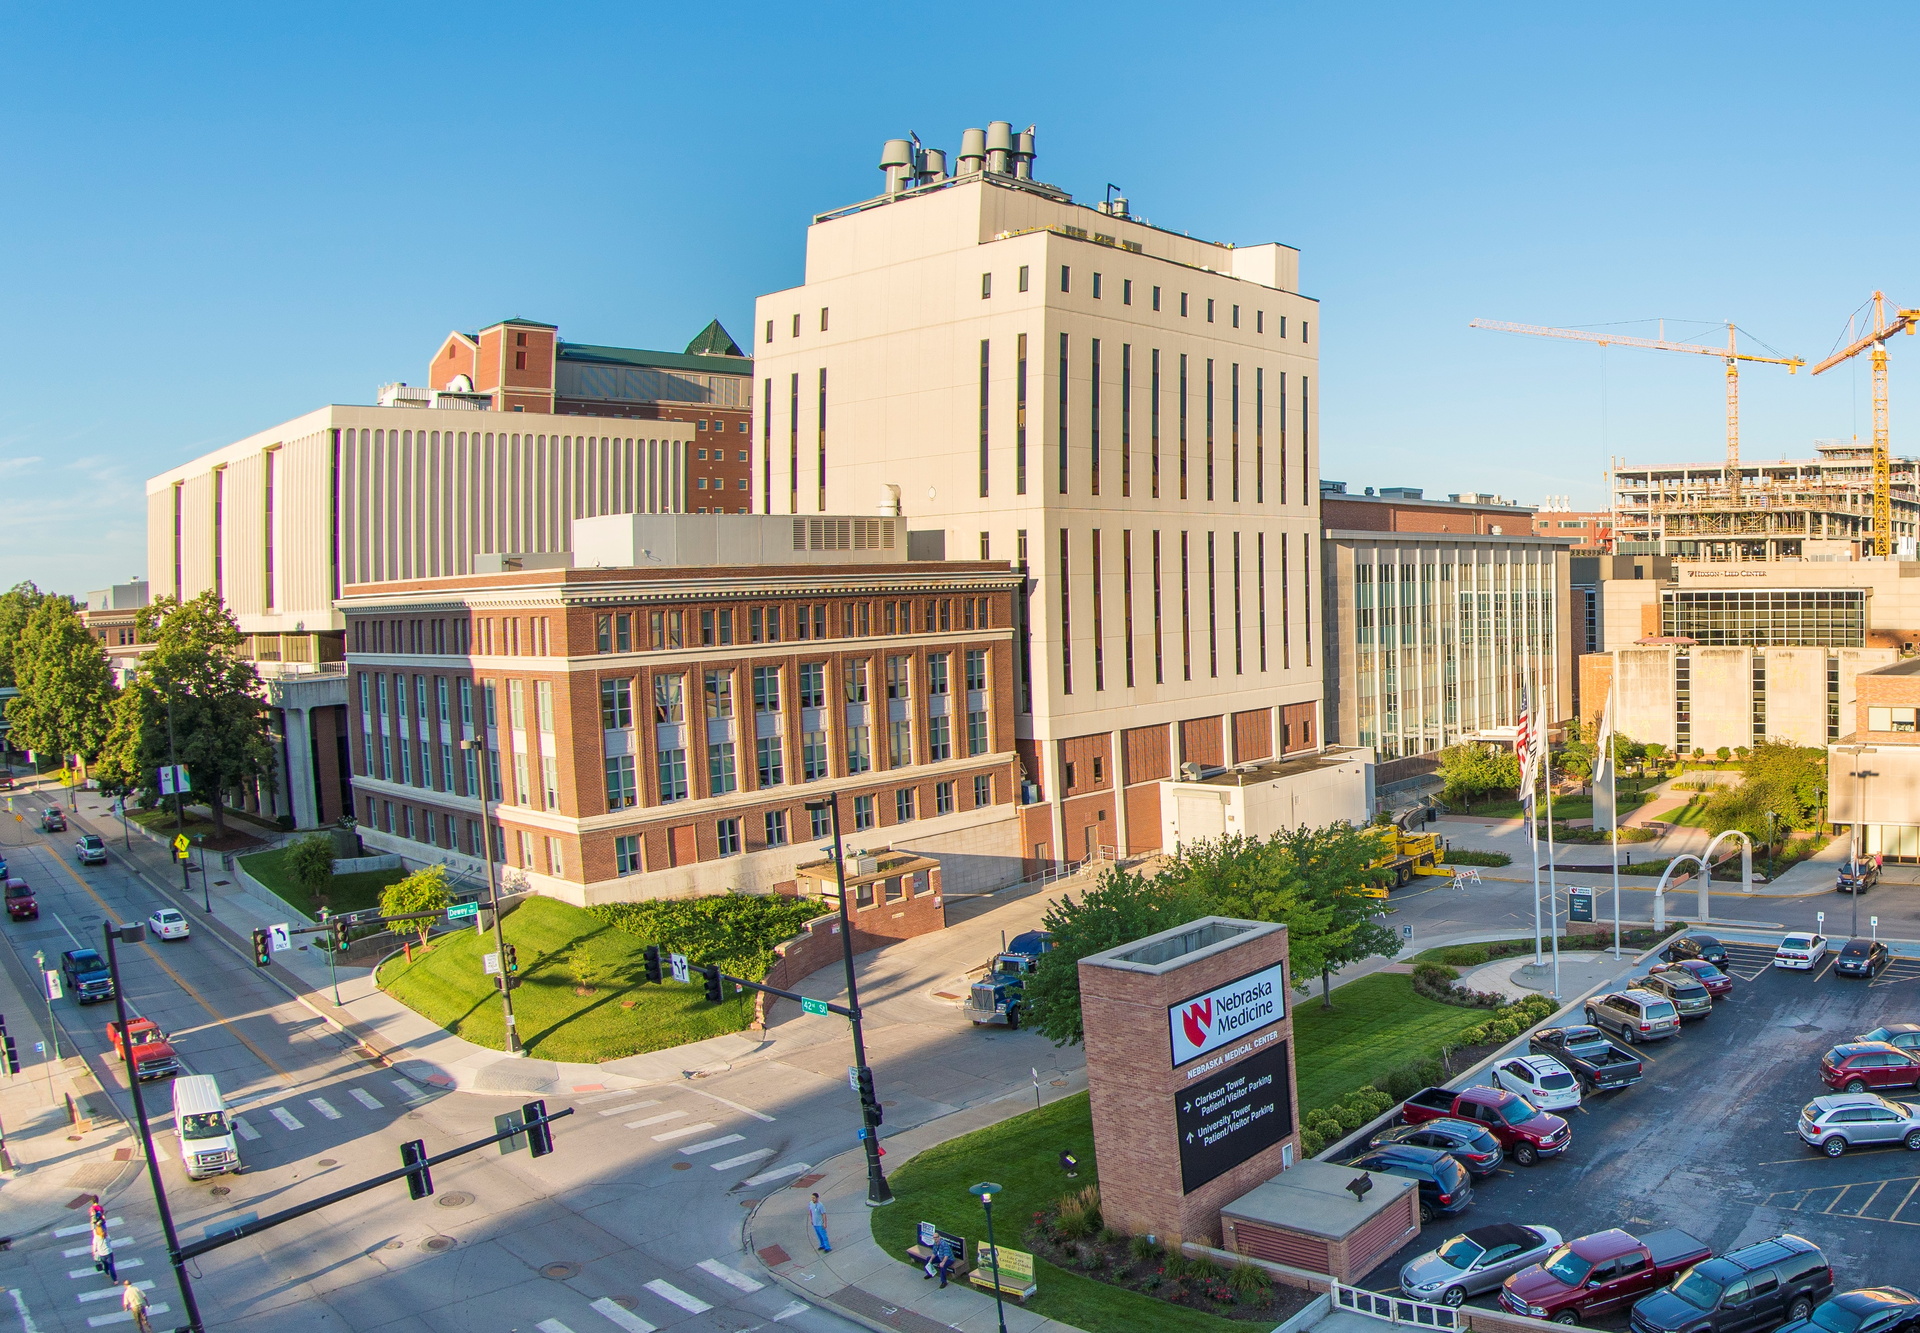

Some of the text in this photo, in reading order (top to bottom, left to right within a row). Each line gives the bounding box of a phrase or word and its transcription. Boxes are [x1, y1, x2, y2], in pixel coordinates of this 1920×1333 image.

[449, 907, 467, 917] Dewey
[1216, 981, 1272, 1016] Nebraska
[1217, 1000, 1273, 1035] Medicine
[1187, 1030, 1278, 1080] NEBRASKA MEDICAL CENTER
[1195, 1076, 1246, 1107] Clarkson Tower
[1201, 1074, 1272, 1117] Patient/Visitor Parking
[1197, 1104, 1251, 1137] University Tower
[1203, 1103, 1274, 1147] Patient/Visitor Parking
